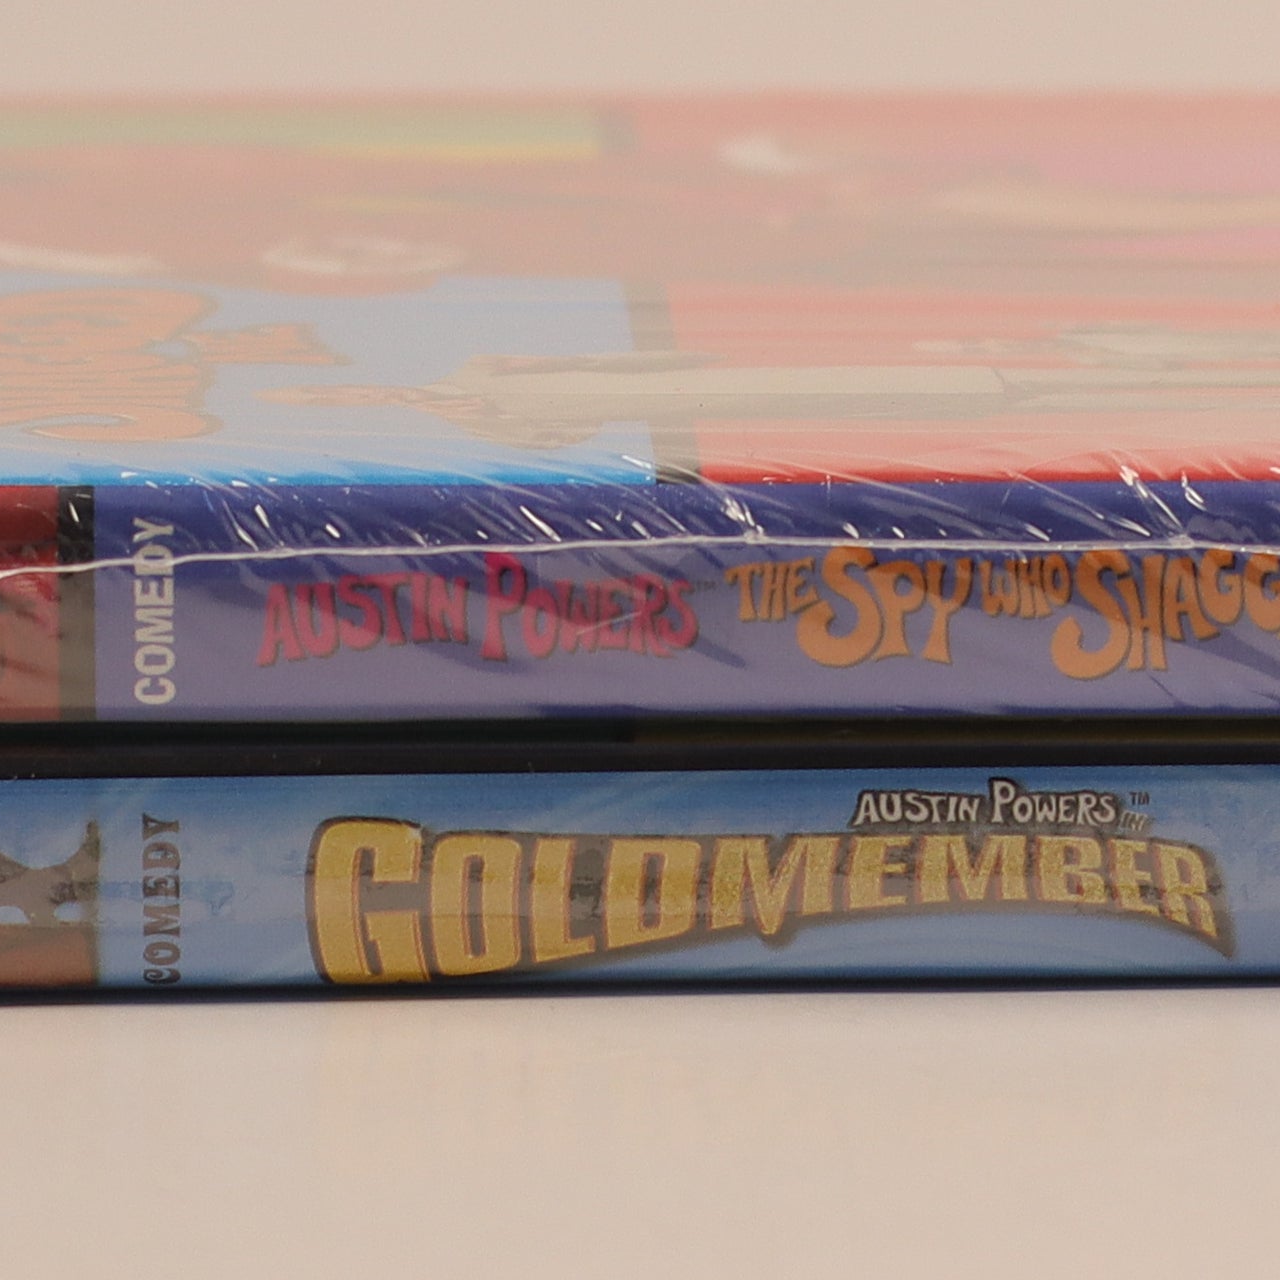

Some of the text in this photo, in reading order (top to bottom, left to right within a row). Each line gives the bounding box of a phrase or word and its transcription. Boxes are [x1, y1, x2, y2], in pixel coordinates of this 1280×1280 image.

[132, 518, 177, 706] COMEDY
[254, 571, 470, 668] AUSTIN
[480, 550, 702, 662] POWERS
[724, 556, 823, 622] THE
[796, 545, 973, 668] SPY
[980, 553, 1070, 620] WHO
[853, 792, 982, 826] AUSTIN
[988, 778, 1117, 826] POWERS
[141, 812, 182, 985] COMEDY
[310, 816, 1222, 984] GOLDMEMBER
